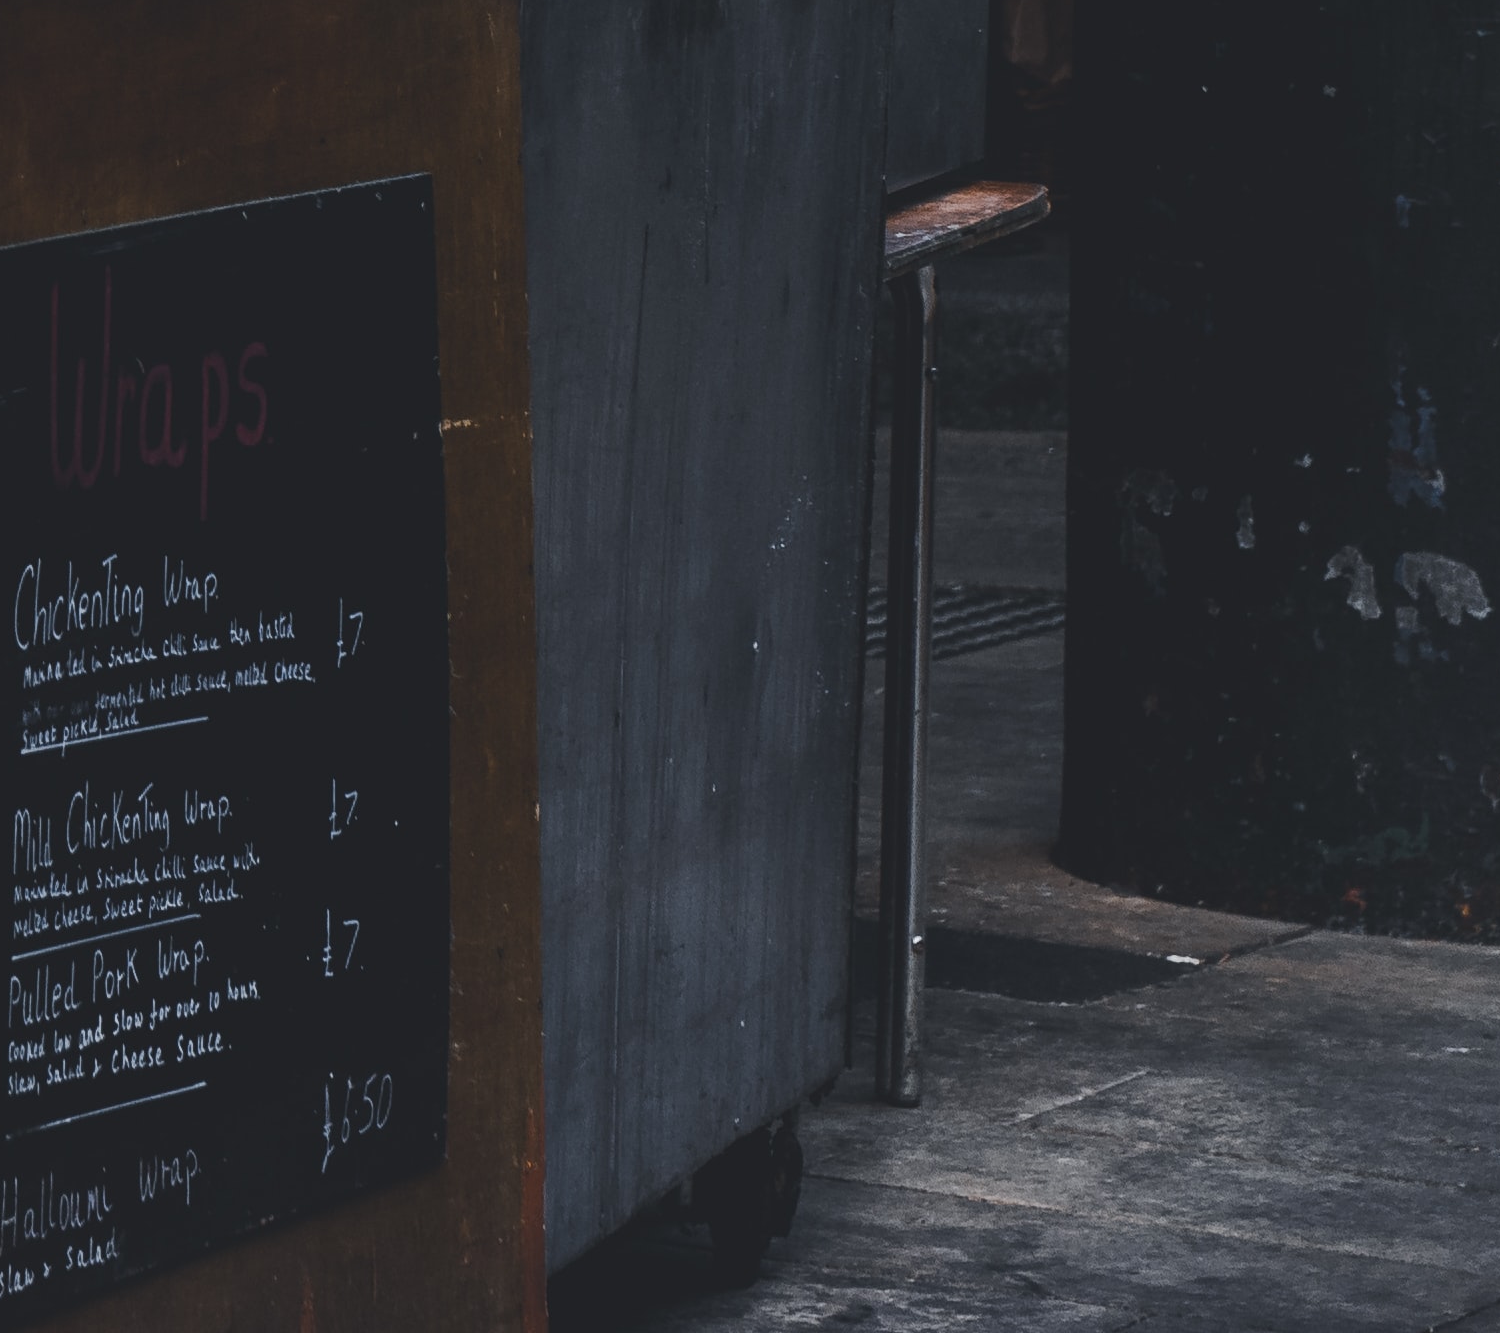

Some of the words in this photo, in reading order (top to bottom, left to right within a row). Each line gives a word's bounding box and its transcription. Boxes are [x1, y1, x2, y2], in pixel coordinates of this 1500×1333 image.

[13, 807, 54, 875] Mild
[77, 864, 90, 895] in
[8, 960, 83, 1028] Pulled
[54, 1029, 72, 1055] low
[79, 1013, 107, 1051] and
[149, 998, 171, 1031] for
[176, 998, 200, 1020] over
[208, 991, 220, 1013] 10
[0, 1166, 115, 1257] Halloumi
